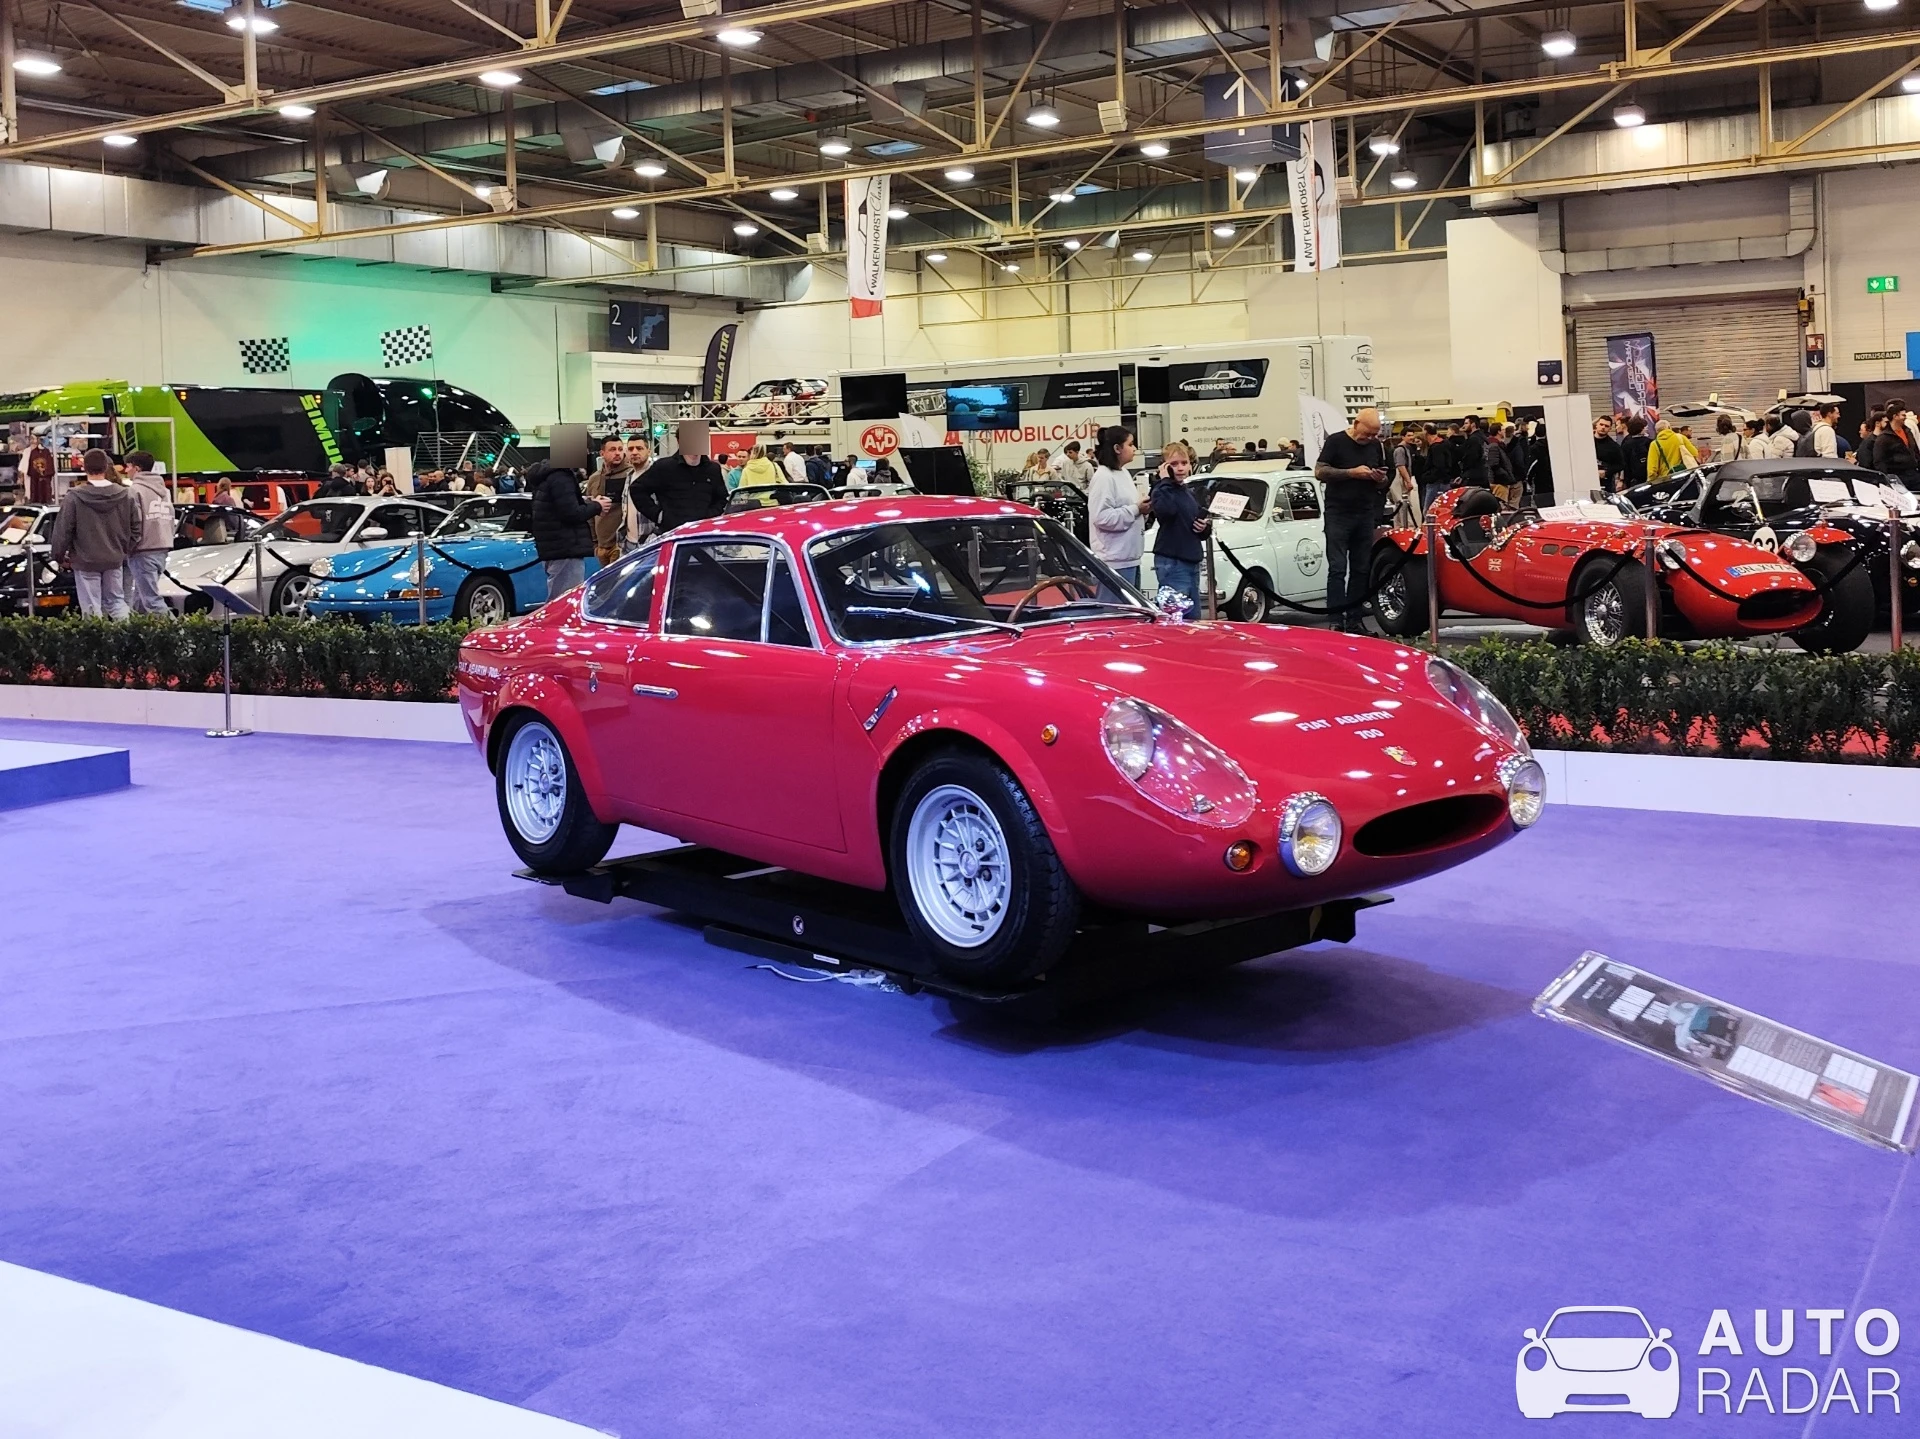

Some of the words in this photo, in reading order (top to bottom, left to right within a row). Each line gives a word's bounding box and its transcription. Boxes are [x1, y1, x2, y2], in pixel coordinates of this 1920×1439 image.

[1223, 76, 1246, 137] 1
[871, 211, 882, 289] WALKENHORST
[611, 304, 621, 325] 2
[713, 331, 730, 401] MULATOR
[1855, 352, 1900, 360] NOTAUSGANG
[1183, 383, 1233, 392] WALKENHORST
[300, 394, 343, 465] SIMUL
[1295, 719, 1331, 731] FIAT
[1334, 711, 1394, 725] ABARTH
[1354, 729, 1384, 739] 700
